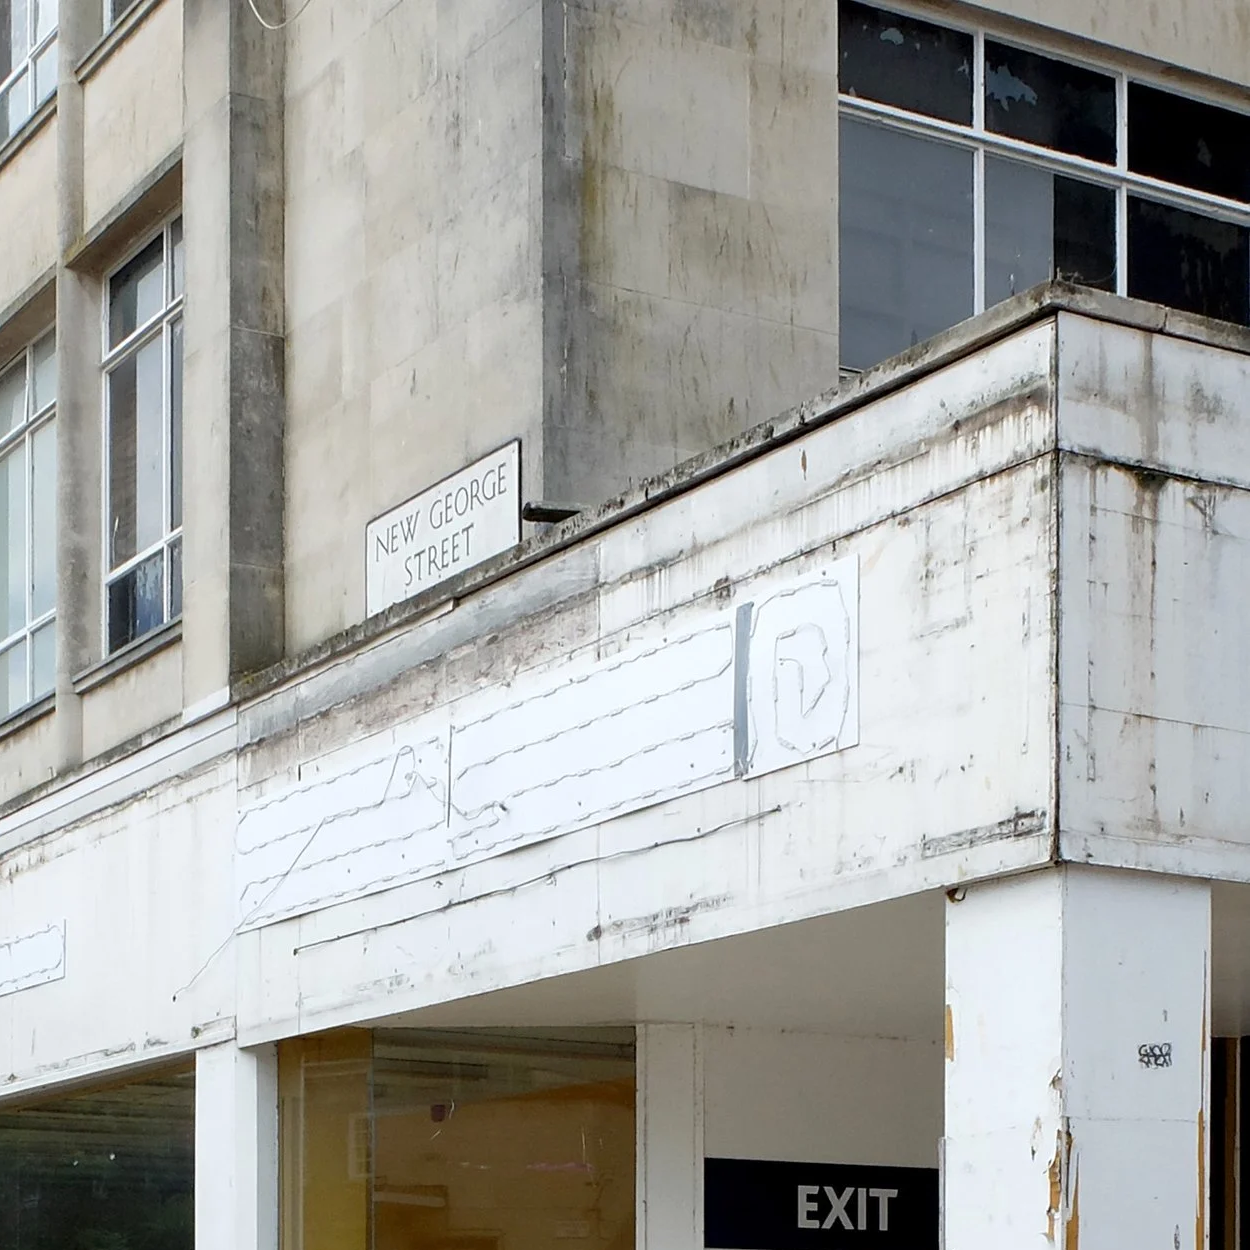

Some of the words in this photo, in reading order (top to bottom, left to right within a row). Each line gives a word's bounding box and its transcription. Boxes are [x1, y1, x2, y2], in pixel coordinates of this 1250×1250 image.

[375, 509, 421, 562] NEW
[429, 462, 507, 530] GEORGE
[404, 522, 475, 587] STREET
[797, 1184, 899, 1231] EXIT
